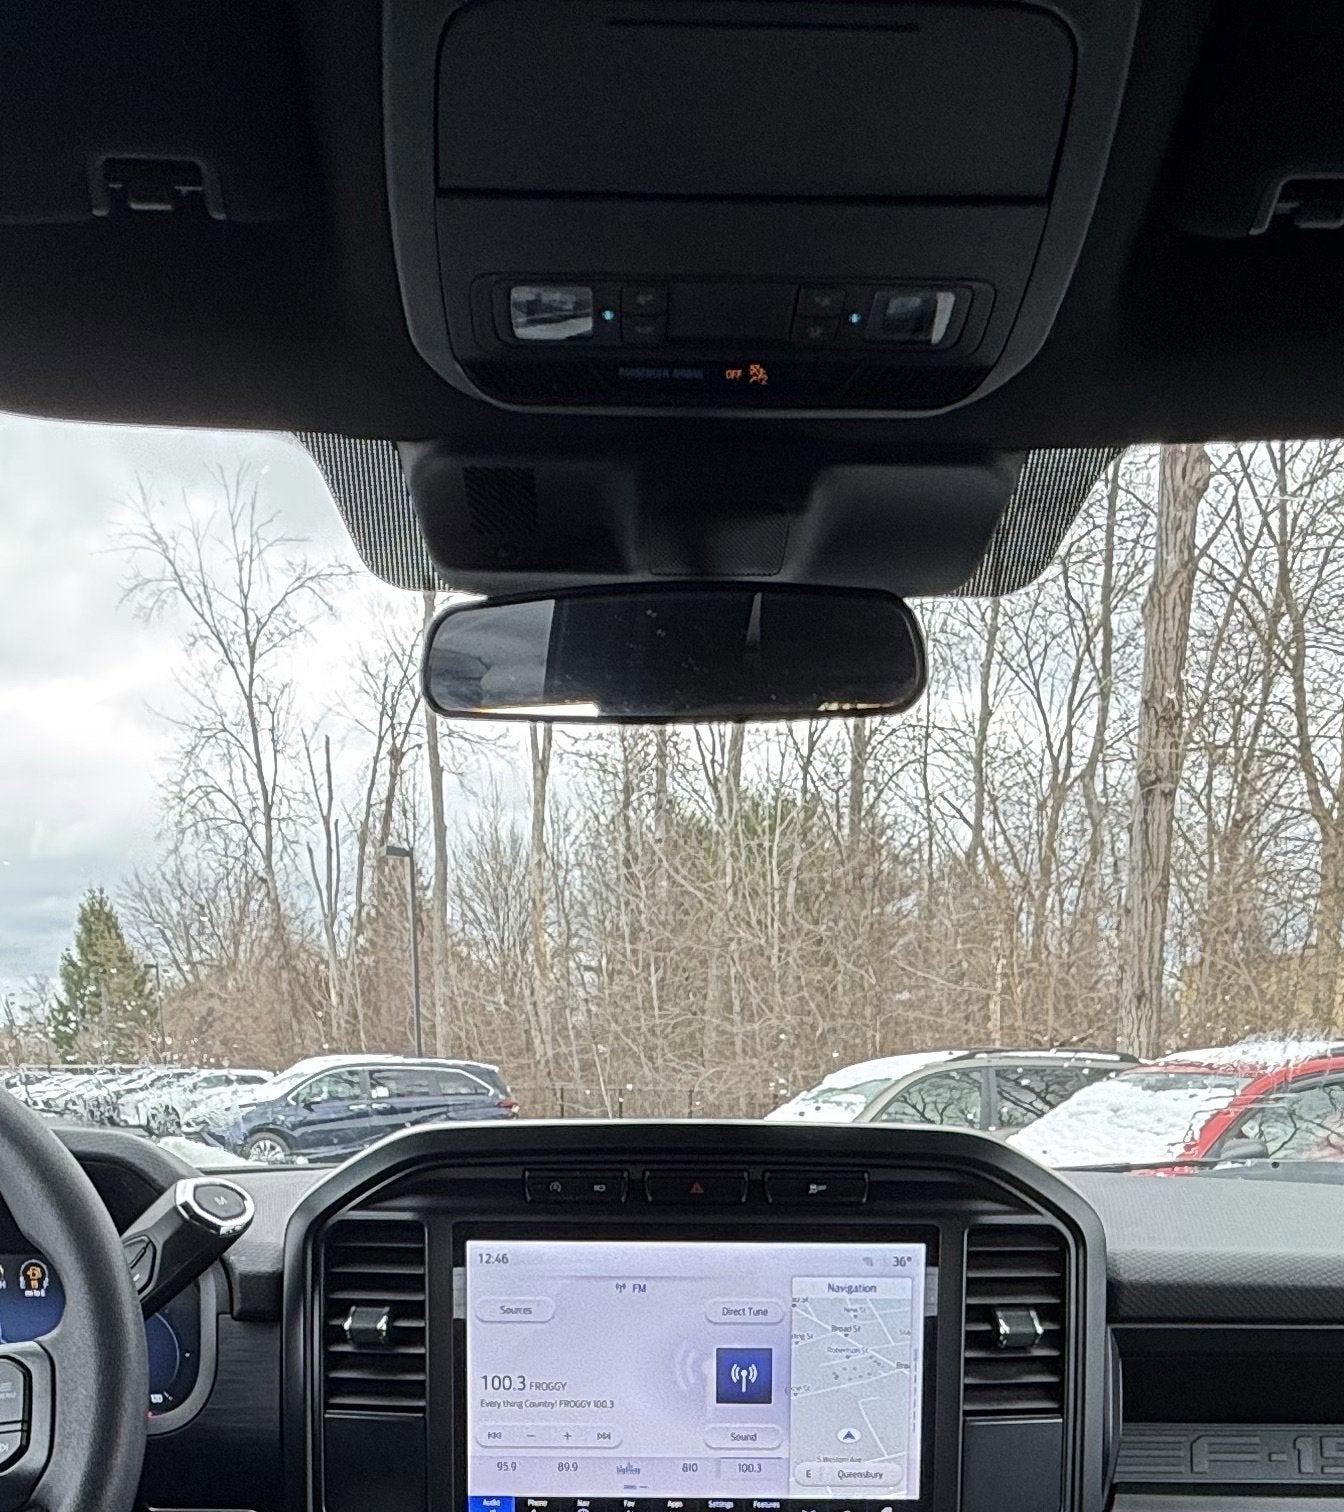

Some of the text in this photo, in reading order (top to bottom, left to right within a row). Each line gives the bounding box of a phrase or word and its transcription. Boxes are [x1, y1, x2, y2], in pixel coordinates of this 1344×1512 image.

[725, 368, 743, 380] OFF
[478, 1253, 510, 1265] 12:46
[632, 1283, 647, 1294] FM
[827, 1282, 878, 1295] Navigation
[500, 1305, 532, 1315] Sources
[722, 1307, 769, 1317] Direct Tune
[480, 1375, 567, 1391] 100.3 FROGGY
[480, 1399, 501, 1409] Every
[559, 1399, 591, 1408] FROGGY
[593, 1399, 614, 1408] 100.3
[730, 1432, 758, 1442] Sound
[497, 1462, 517, 1472] 95.9
[557, 1461, 578, 1472] 89.9
[682, 1463, 698, 1473] 810
[738, 1463, 762, 1473] 100.3
[837, 1470, 883, 1480] Queensbury
